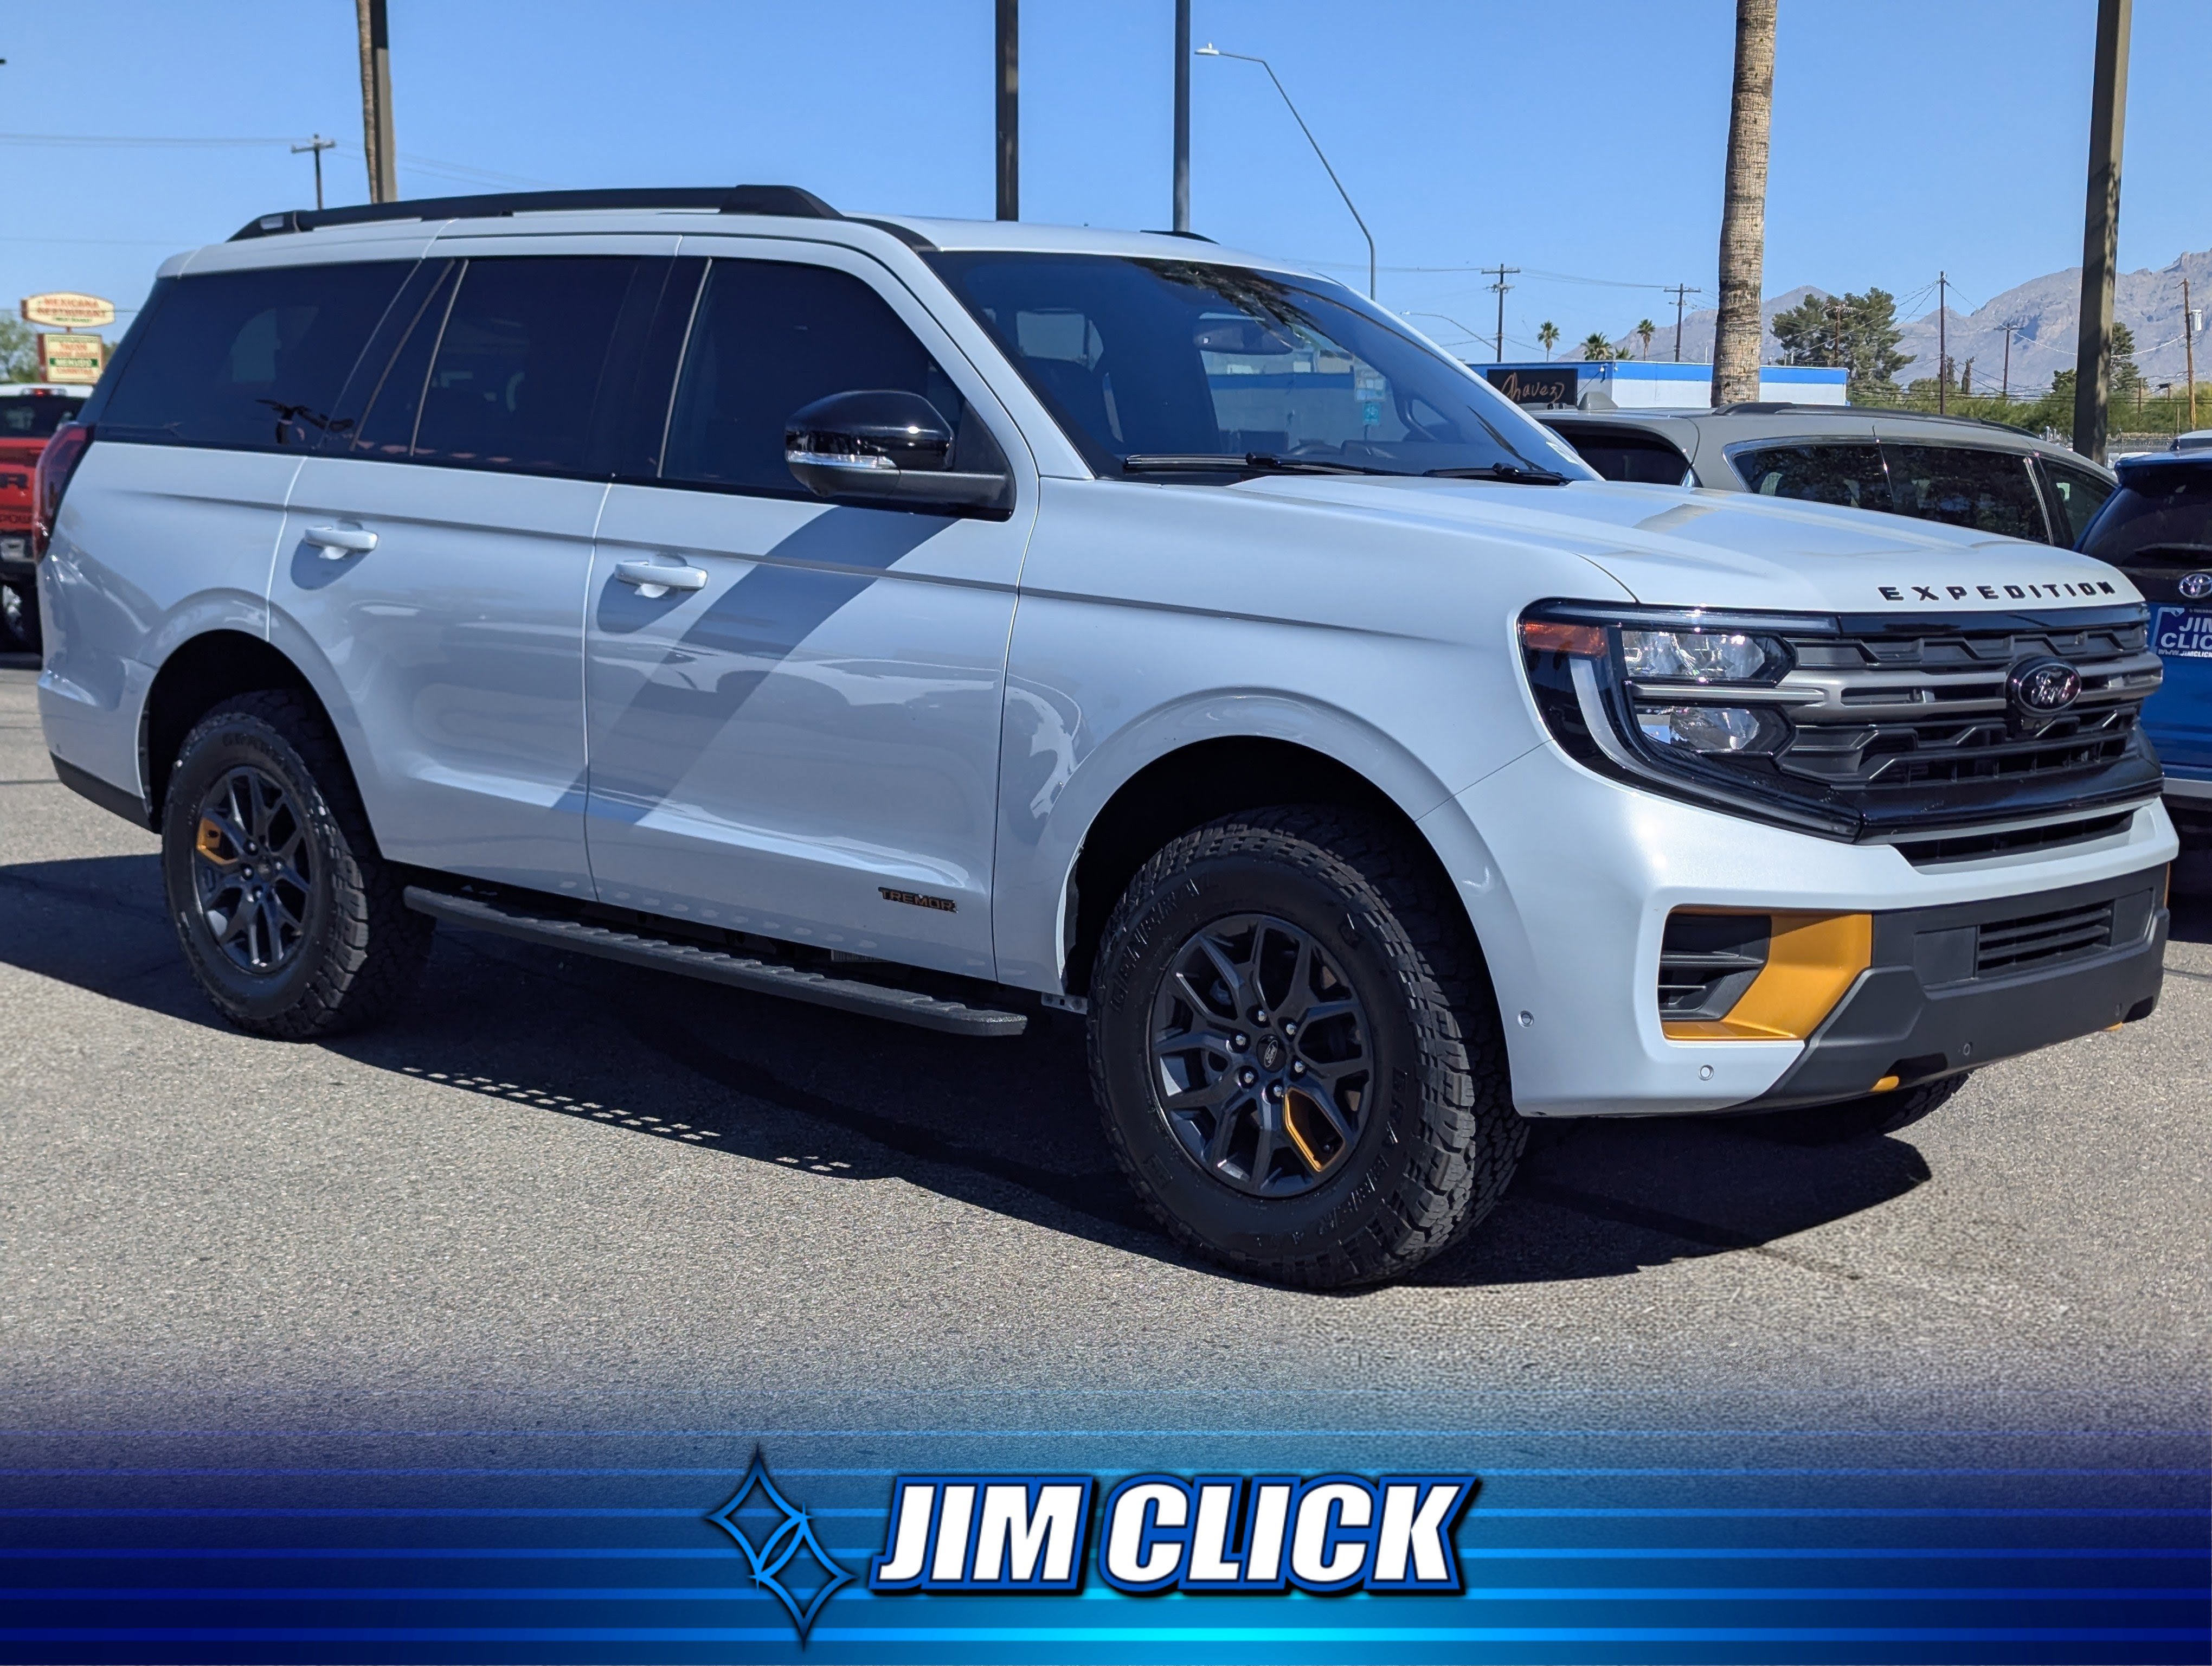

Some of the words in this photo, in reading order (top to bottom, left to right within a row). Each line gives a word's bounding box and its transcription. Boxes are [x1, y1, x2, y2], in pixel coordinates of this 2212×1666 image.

[1501, 372, 1565, 404] Chavez
[1877, 581, 2116, 601] EXPEDITION
[878, 887, 957, 913] TREMOR
